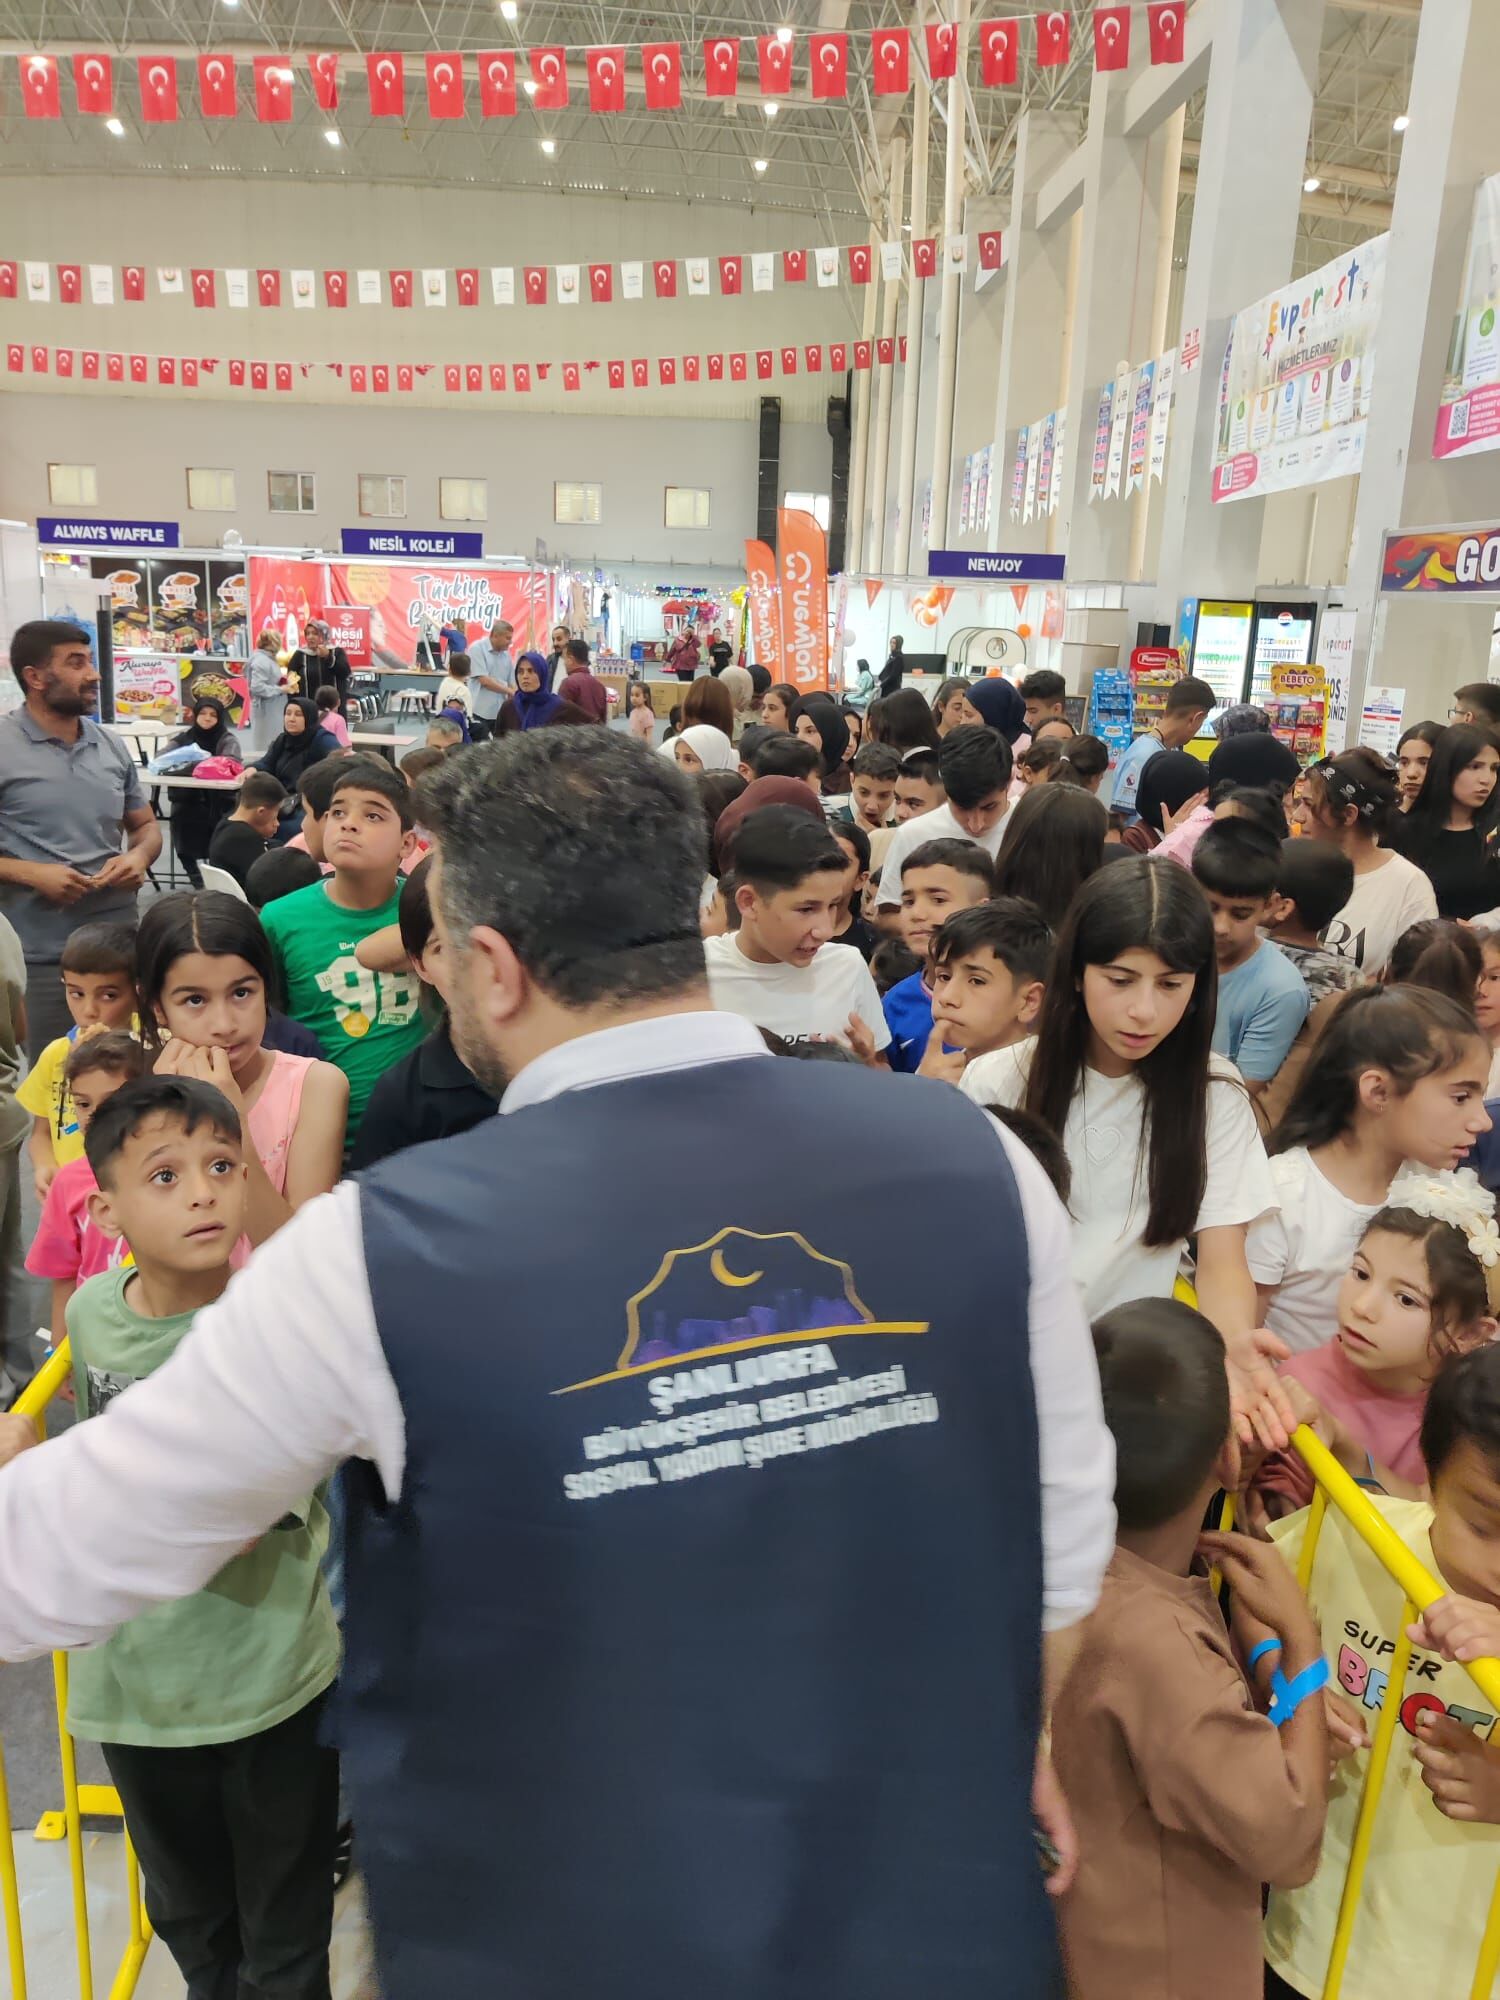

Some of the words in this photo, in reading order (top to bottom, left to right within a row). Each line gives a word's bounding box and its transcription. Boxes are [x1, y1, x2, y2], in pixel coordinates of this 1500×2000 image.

[53, 524, 108, 541] ALWAYS
[110, 526, 165, 543] WAFFLE
[368, 535, 407, 552] NESİL
[409, 537, 454, 554] KOLEJİ
[967, 557, 1023, 573] NEWJOY
[412, 572, 489, 611] Türkiye
[1280, 674, 1316, 685] BEBETO
[562, 1460, 659, 1500] SOSYAL
